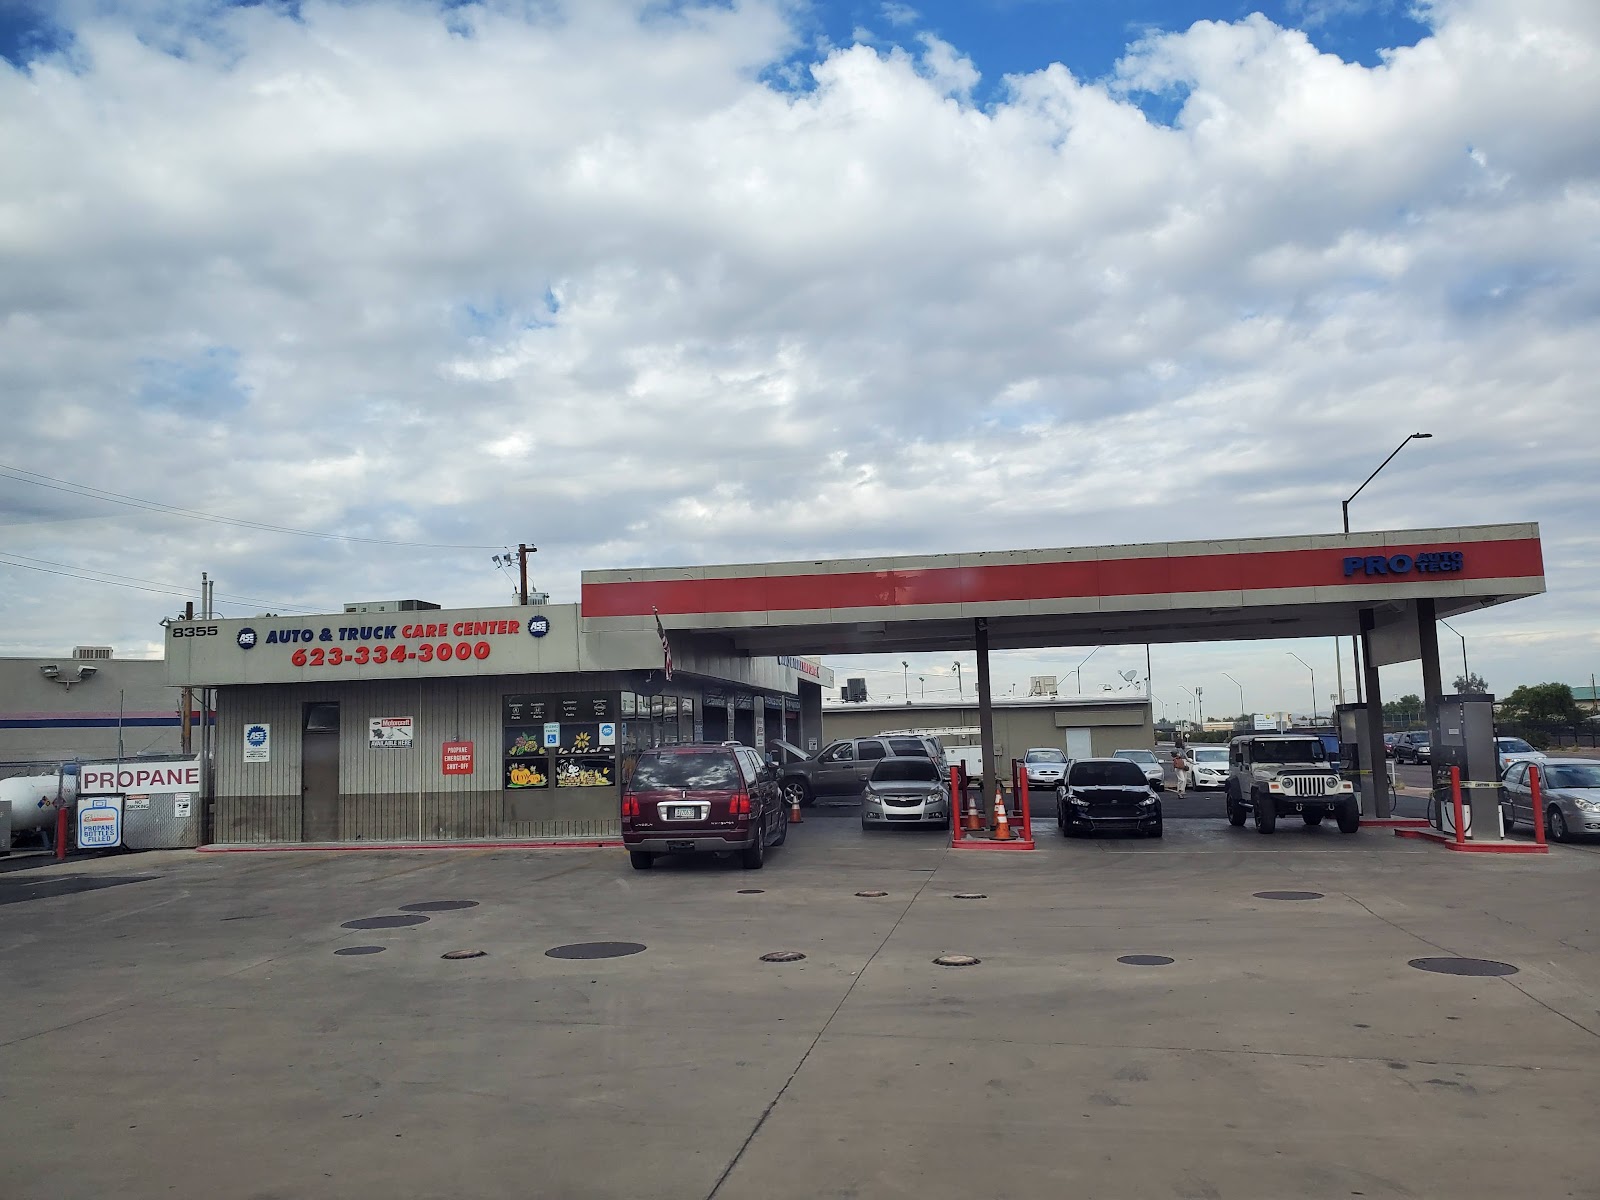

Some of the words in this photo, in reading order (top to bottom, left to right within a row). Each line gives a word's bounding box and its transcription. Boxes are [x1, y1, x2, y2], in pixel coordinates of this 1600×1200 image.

[1416, 551, 1463, 562] AUTO
[1343, 554, 1412, 576] PRO
[1416, 561, 1463, 572] TECH
[530, 621, 547, 630] ASE
[172, 626, 218, 638] 8355
[239, 633, 254, 642] ASE
[266, 629, 314, 644] AUTO
[319, 627, 333, 642] &
[338, 625, 397, 641] TRUCK
[402, 623, 448, 639] CARE
[453, 620, 520, 636] CENTER
[291, 641, 491, 667] 623-334-3000
[382, 719, 410, 727] Motorcraft
[250, 731, 264, 740] ASE
[84, 768, 199, 789] PROPANE
